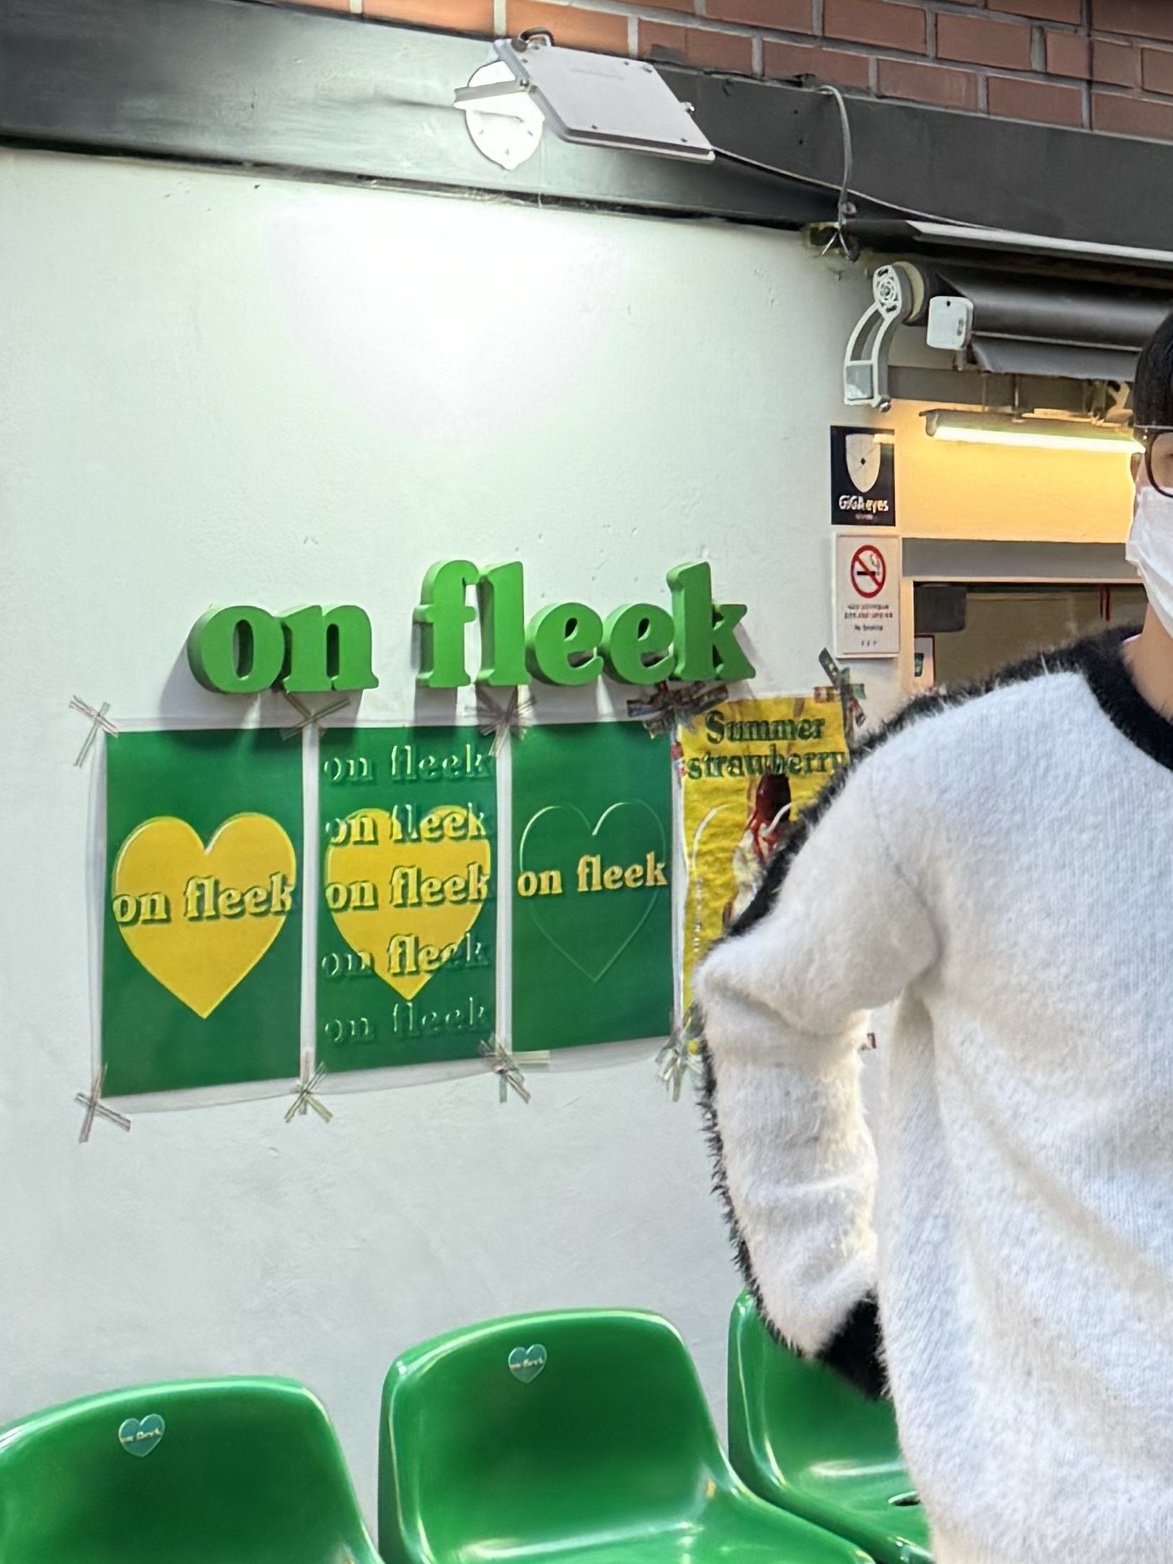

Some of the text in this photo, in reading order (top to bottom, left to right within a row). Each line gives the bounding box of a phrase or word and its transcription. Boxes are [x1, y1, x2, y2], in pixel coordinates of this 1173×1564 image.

[187, 559, 757, 695] on fleek
[705, 710, 826, 744] Summer
[323, 743, 491, 783] on fleek
[687, 743, 846, 780] strawberry
[325, 817, 377, 845] on
[325, 861, 489, 911] on fleek
[517, 851, 669, 897] on fleek
[112, 871, 295, 927] on fleek
[321, 951, 374, 978] on
[324, 1017, 374, 1043] on
